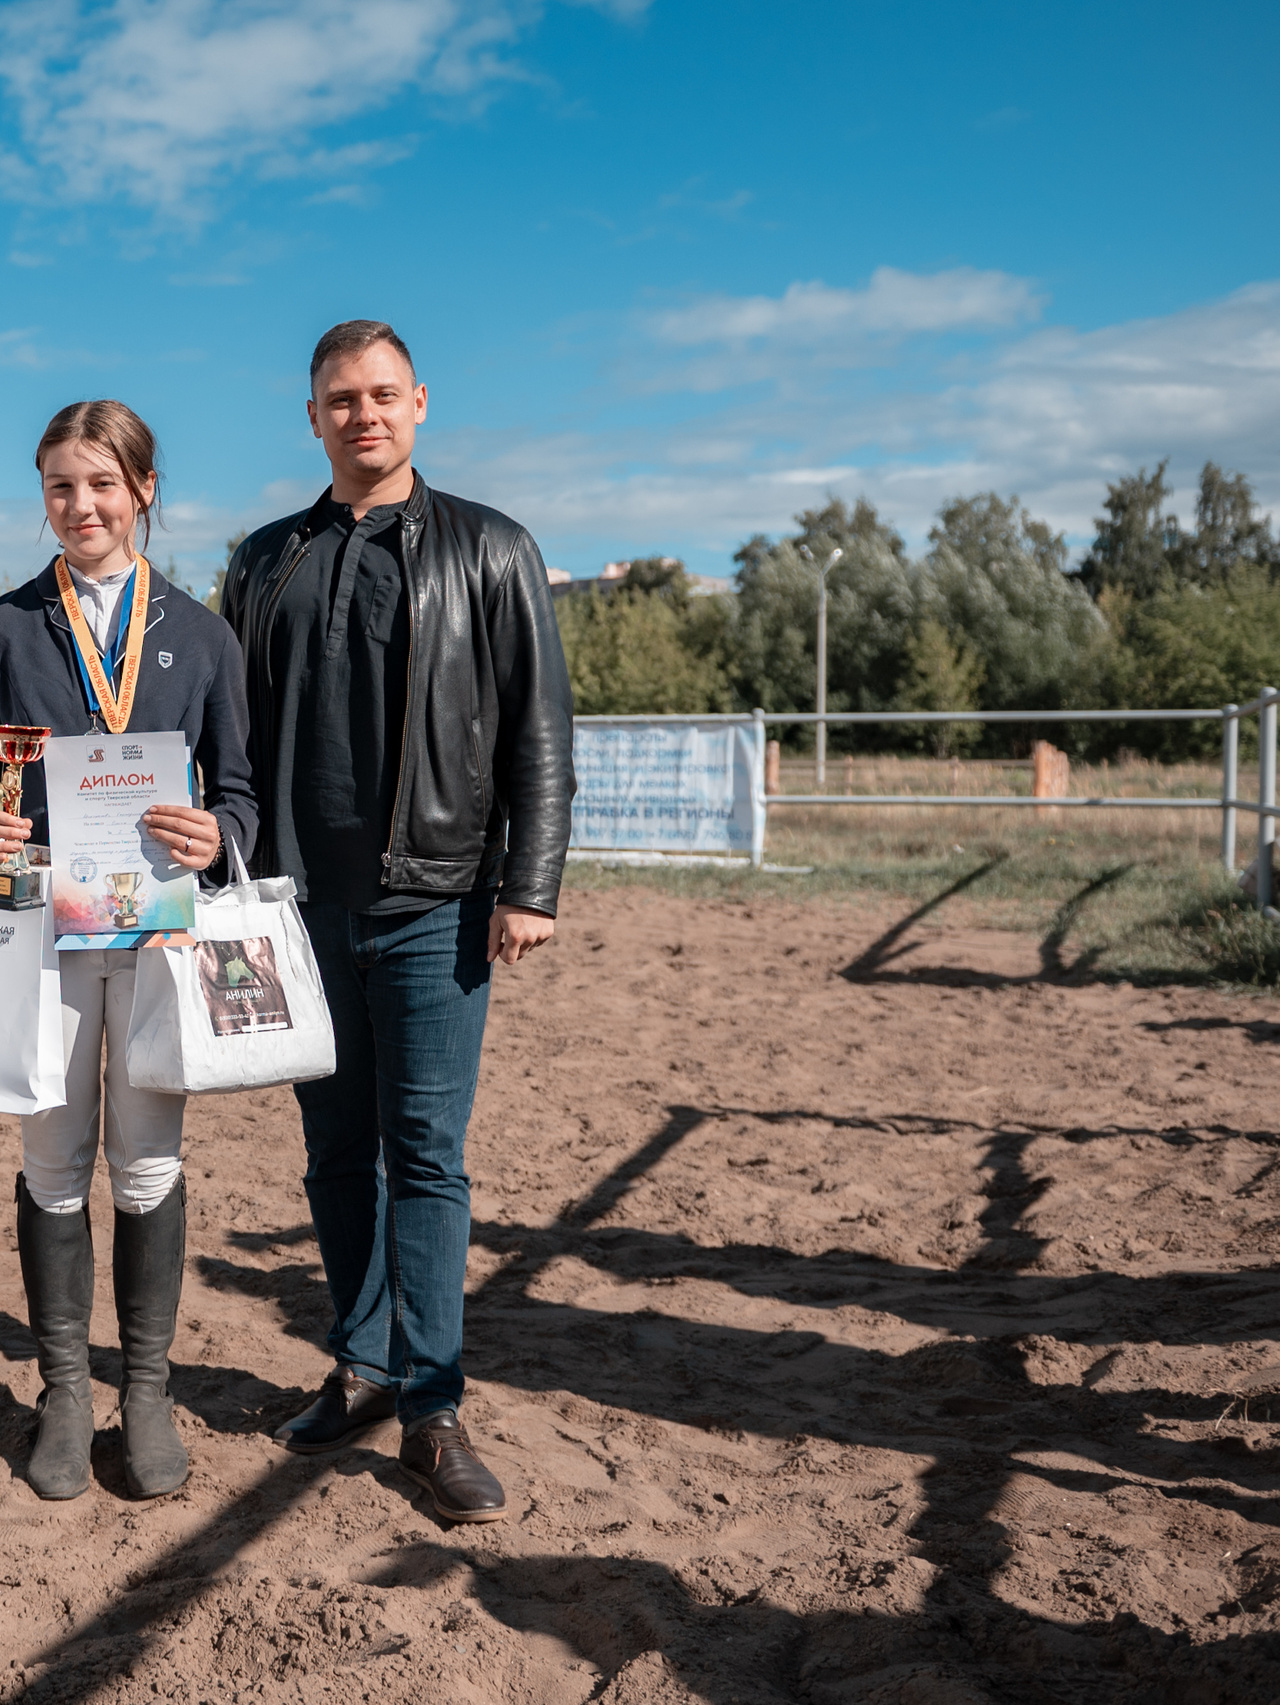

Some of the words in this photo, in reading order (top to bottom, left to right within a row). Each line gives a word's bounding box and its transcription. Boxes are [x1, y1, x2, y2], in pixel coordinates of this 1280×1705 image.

[57, 560, 70, 589] ОБЛАСТЬ
[63, 588, 81, 622] ТВЕРСКАЯ
[135, 588, 146, 618] ОБЛАСТЬ
[88, 654, 105, 690] ОБЛАСТЬ
[122, 655, 137, 691] ТВЕРСКАЯ
[100, 688, 118, 727] ТВЕРСКАЯ
[117, 690, 131, 725] ОБЛАСТЬ
[617, 749, 692, 760] подкормки
[645, 763, 731, 775] экипировка
[80, 773, 154, 790] ДИПЛОМ
[572, 806, 639, 818] ТПРАВКА
[644, 807, 655, 818] В
[658, 806, 735, 819] РЕГИОНЫ
[225, 987, 265, 1001] АНИЛИН
